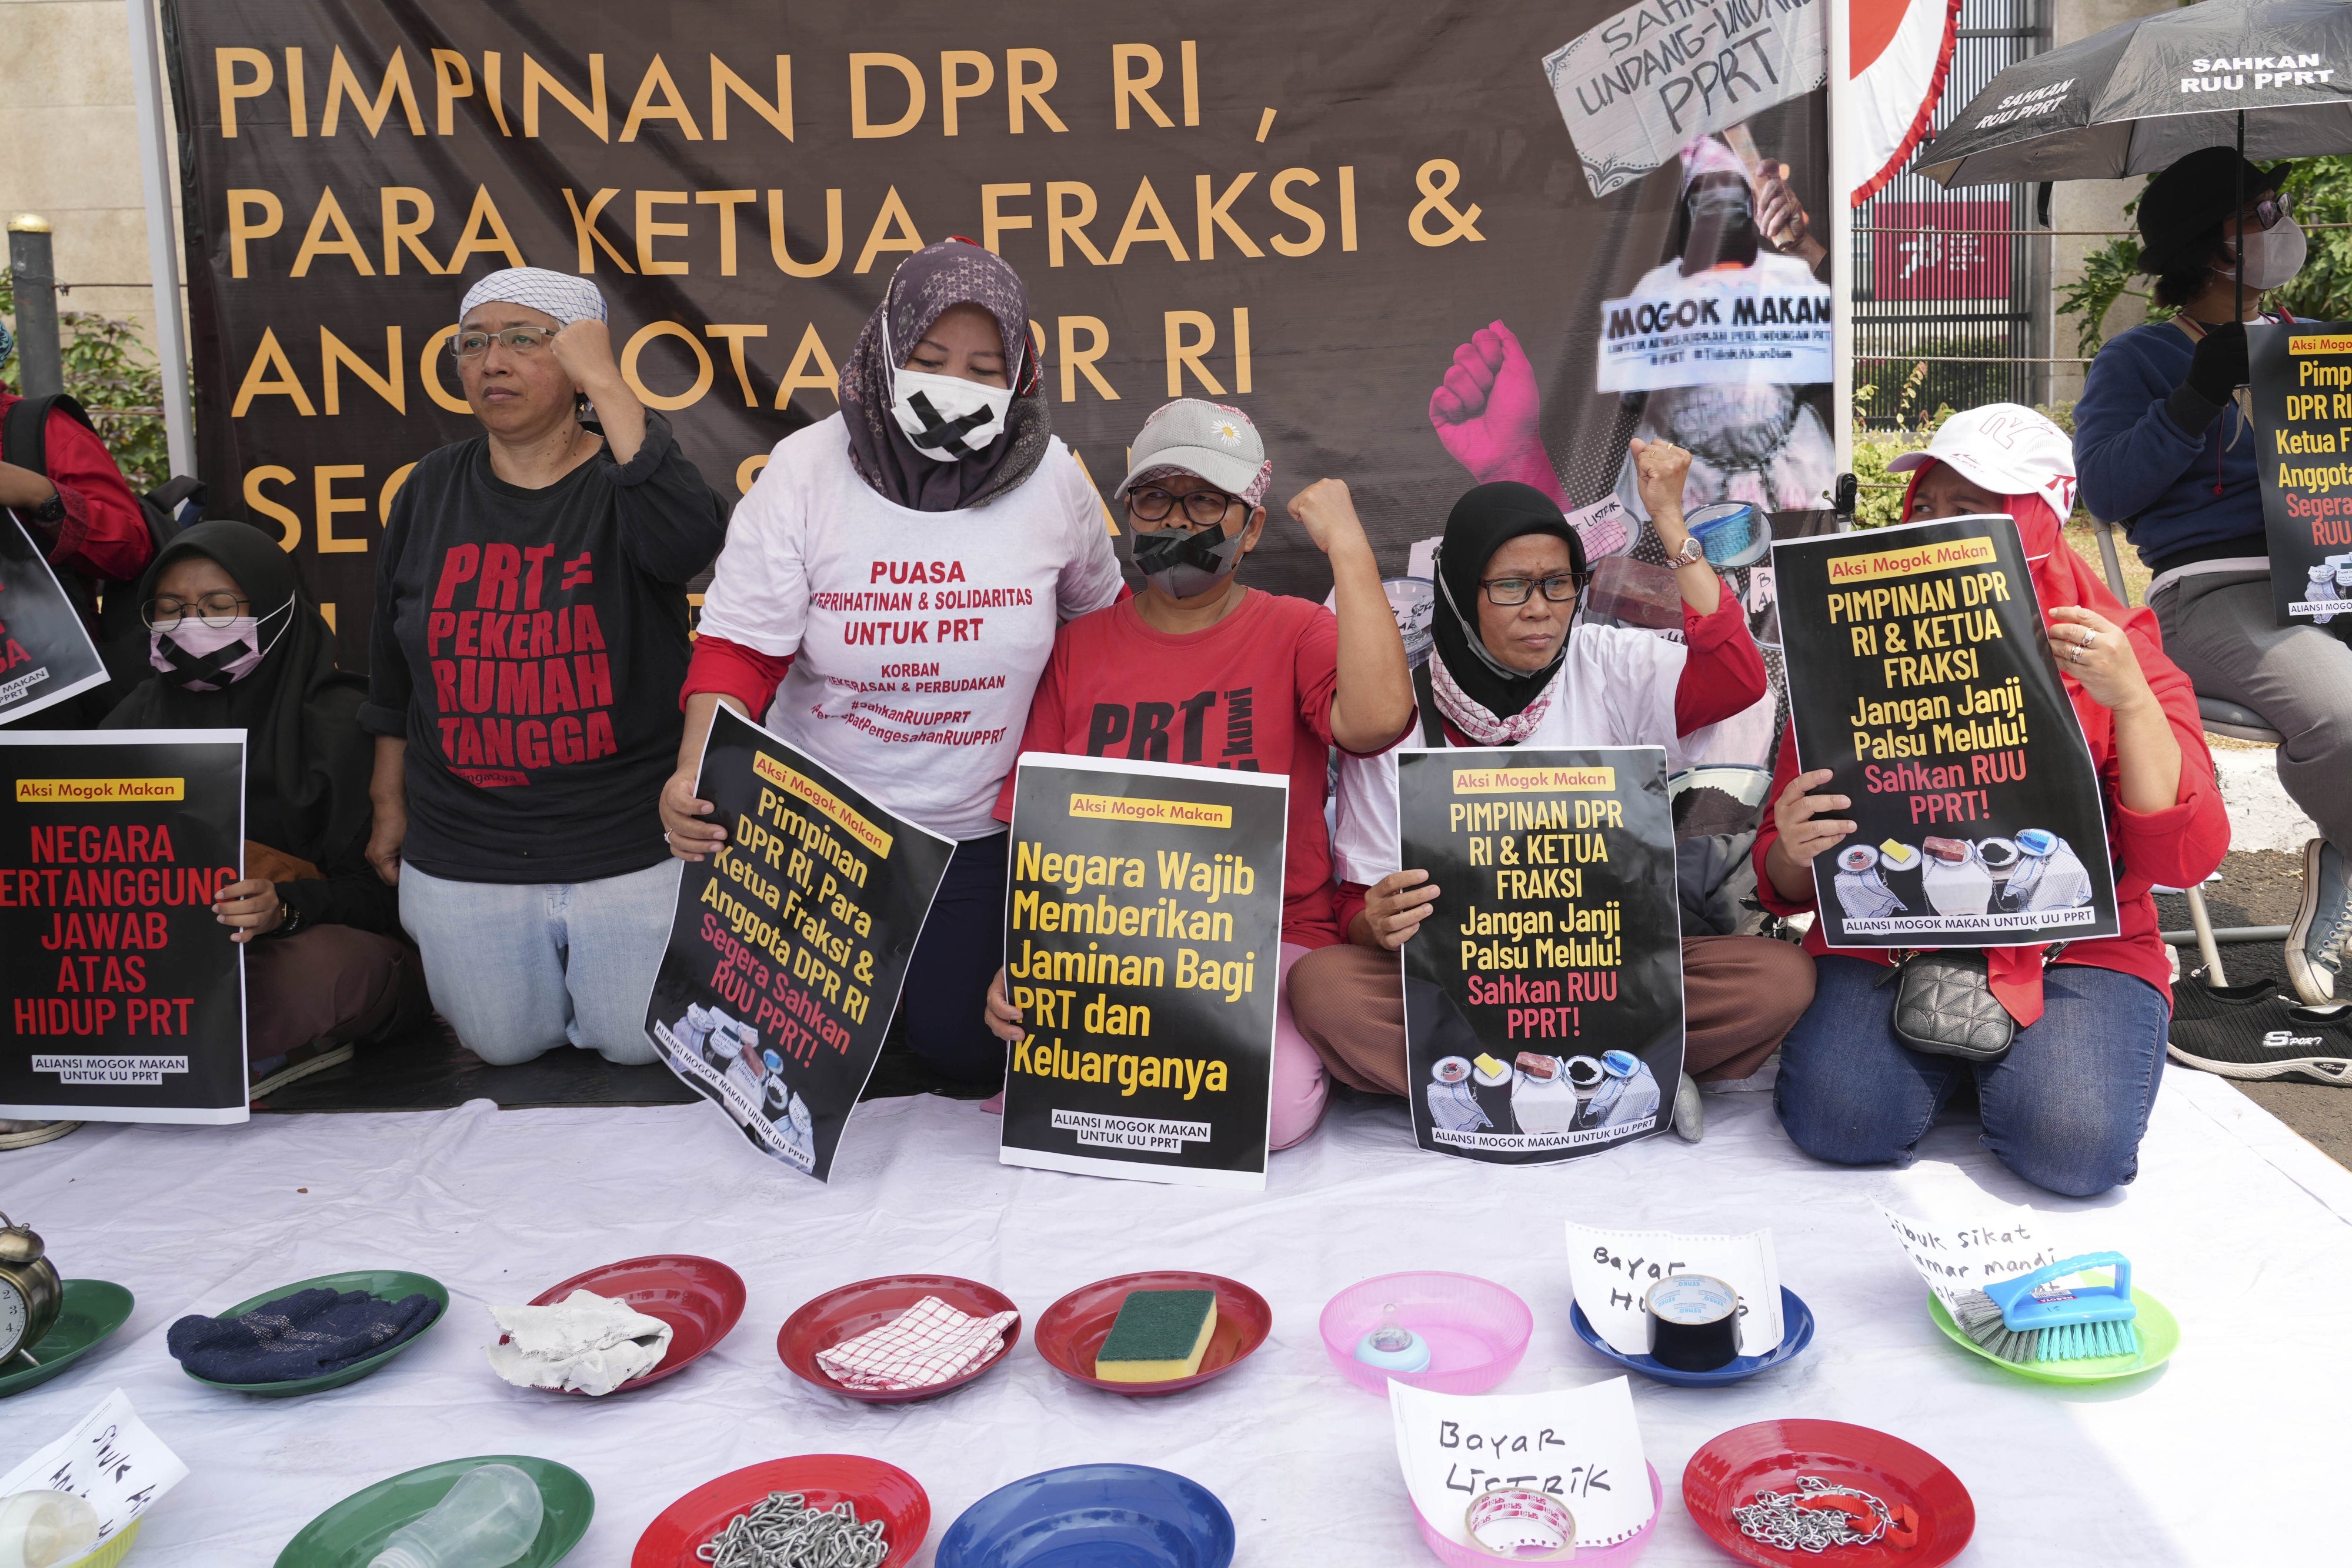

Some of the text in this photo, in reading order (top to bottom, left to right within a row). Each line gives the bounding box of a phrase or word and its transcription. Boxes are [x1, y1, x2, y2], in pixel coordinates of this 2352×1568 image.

[1659, 26, 1778, 134] PPRT
[2181, 69, 2334, 93] RUU PPRT
[2192, 54, 2318, 73] SAHKAN
[215, 40, 1200, 144] PIMPINAN DPR RI
[1998, 78, 2075, 110] SAHKAN
[1974, 95, 2068, 130] RUU PPRT
[227, 159, 1487, 278] PARA KETUA FRAKSI &
[1608, 296, 1831, 339] MOGOK MAKAN
[1164, 307, 1252, 397] RI
[2291, 340, 2316, 350] Aksi
[2287, 395, 2328, 421] DPR
[2276, 429, 2336, 454] Ketua
[2311, 521, 2351, 545] RUU
[432, 543, 555, 611] PRT
[870, 561, 966, 584] PUASA
[1833, 545, 1988, 577] Aksi Mogok Makan
[919, 588, 1032, 610] & SOLIDARITAS
[1828, 571, 2010, 623] PIMPINAN DPR
[2291, 604, 2323, 612] ALIANSI
[428, 605, 606, 659] PEKERJA
[844, 618, 983, 645] UNTUK PRT
[1851, 609, 2002, 656] RI & KETUA
[3, 670, 45, 693] MAKAN
[431, 653, 613, 715] RUMAH
[882, 663, 939, 678] KORBAN
[901, 675, 1005, 693] & PERBUDAKAN
[1884, 649, 1979, 689] FRAKSI
[1851, 677, 2023, 730] Jangan Janji
[438, 710, 618, 770] TANGGA
[1087, 691, 1216, 764] PRT
[1853, 713, 2029, 761] Palsu Melulu!
[1457, 771, 1606, 789] Aksi Mogok Makan
[1865, 750, 2026, 793] Sahkan RUU
[20, 783, 175, 799] Aksi Mogok Makan
[756, 758, 882, 849] Aksi Mogok Makan
[1910, 790, 1990, 825] PPRT!
[1073, 799, 1223, 822] Aksi Mogok Makan
[1450, 800, 1623, 832] PIMPINAN DPR
[31, 825, 175, 863] NEGARA
[758, 786, 868, 889] Pimpinan
[1470, 833, 1609, 866] RI & KETUA
[736, 813, 872, 938] DPR RI, Para
[1016, 841, 1255, 903] Negara Wajib
[1497, 868, 1582, 900] FRAKSI
[41, 912, 168, 950] JAWAB
[713, 846, 875, 986] Ketua Fraksi &
[1013, 890, 1233, 942] Memberikan
[1460, 900, 1620, 942] Jangan Janji
[1846, 910, 2091, 932] ALIANSI MOGOK MAKAN UNTUK UU PPRT
[700, 876, 870, 1025] Anggota DPR RI
[1462, 936, 1622, 970] Palsu Melulu!
[57, 955, 146, 993] ATAS
[700, 912, 851, 1056] Segera Sahkan
[1009, 940, 1255, 1003] Jaminan Bagi
[1468, 972, 1617, 1005] Sahkan RUU
[14, 998, 194, 1035] HIDUP PRT
[710, 960, 819, 1069] RUU PPRT!
[1013, 986, 1150, 1036] PRT dan
[1508, 1007, 1580, 1039] PPRT!
[35, 1059, 185, 1069] ALIANSI MOGOK MAKAN
[63, 1071, 159, 1080] UNTUK UU PPRT
[1013, 1034, 1228, 1100] Keluarganya
[656, 1024, 684, 1057] ALIANSI
[683, 1052, 719, 1084] MOGOK
[719, 1076, 749, 1110] MAKAN
[748, 1107, 773, 1137] UNTUK
[789, 1147, 811, 1165] PPRT
[1055, 1114, 1207, 1137] ALIANSI MOGOK MAKAN
[1080, 1130, 1179, 1149] UNTUK UU PPRT
[1435, 1118, 1654, 1147] ALIANSI MOGOK MAKAN UNTUK UU PPRT
[3, 1289, 11, 1299] 2
[9, 1305, 18, 1315] 3
[6, 1323, 14, 1332] 4
